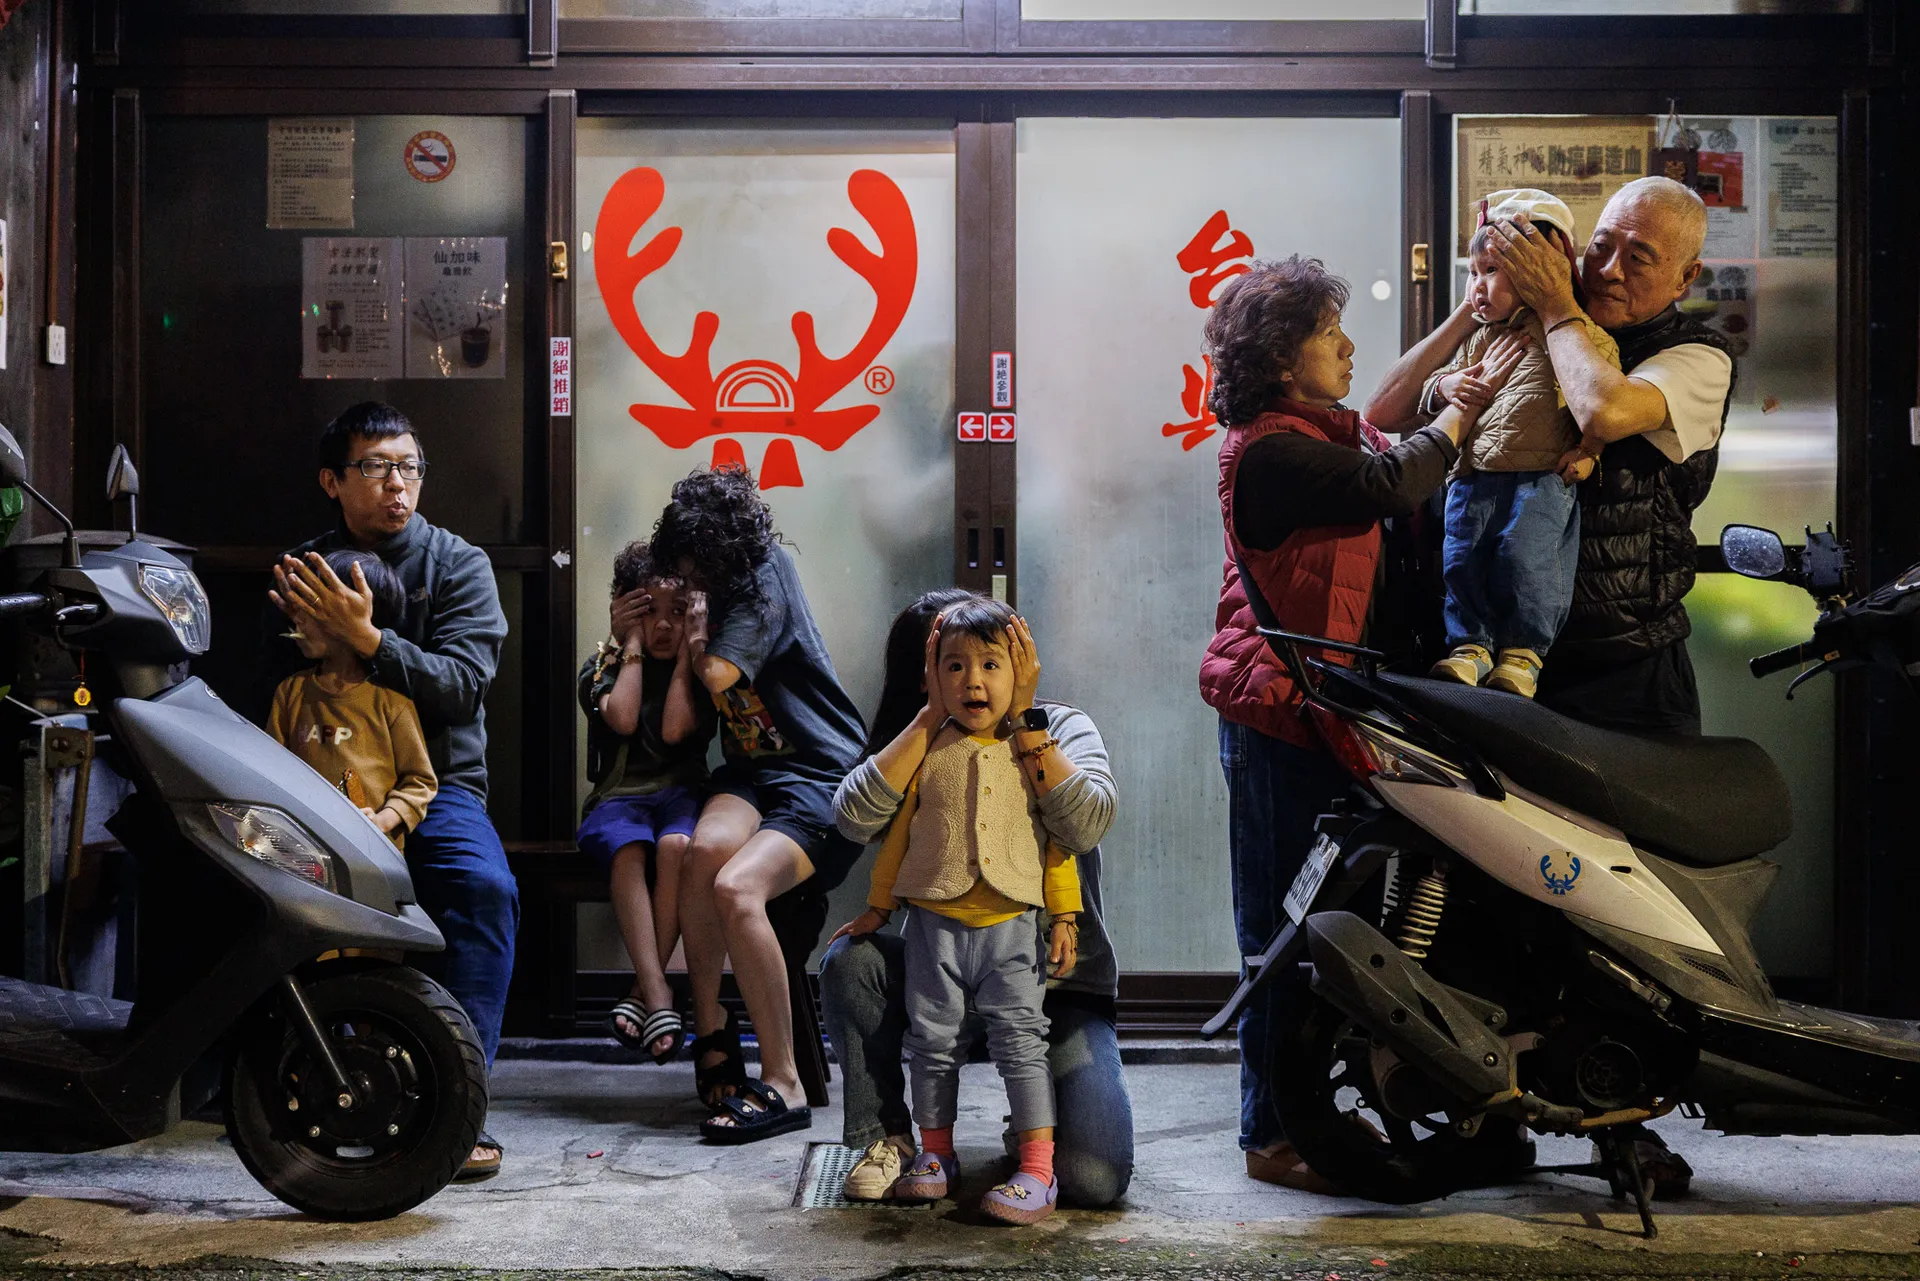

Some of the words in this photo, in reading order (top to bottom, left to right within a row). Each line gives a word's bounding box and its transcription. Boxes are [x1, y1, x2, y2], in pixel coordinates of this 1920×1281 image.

[433, 250, 481, 264] 仙加味
[553, 340, 568, 413] 謝絕推銷
